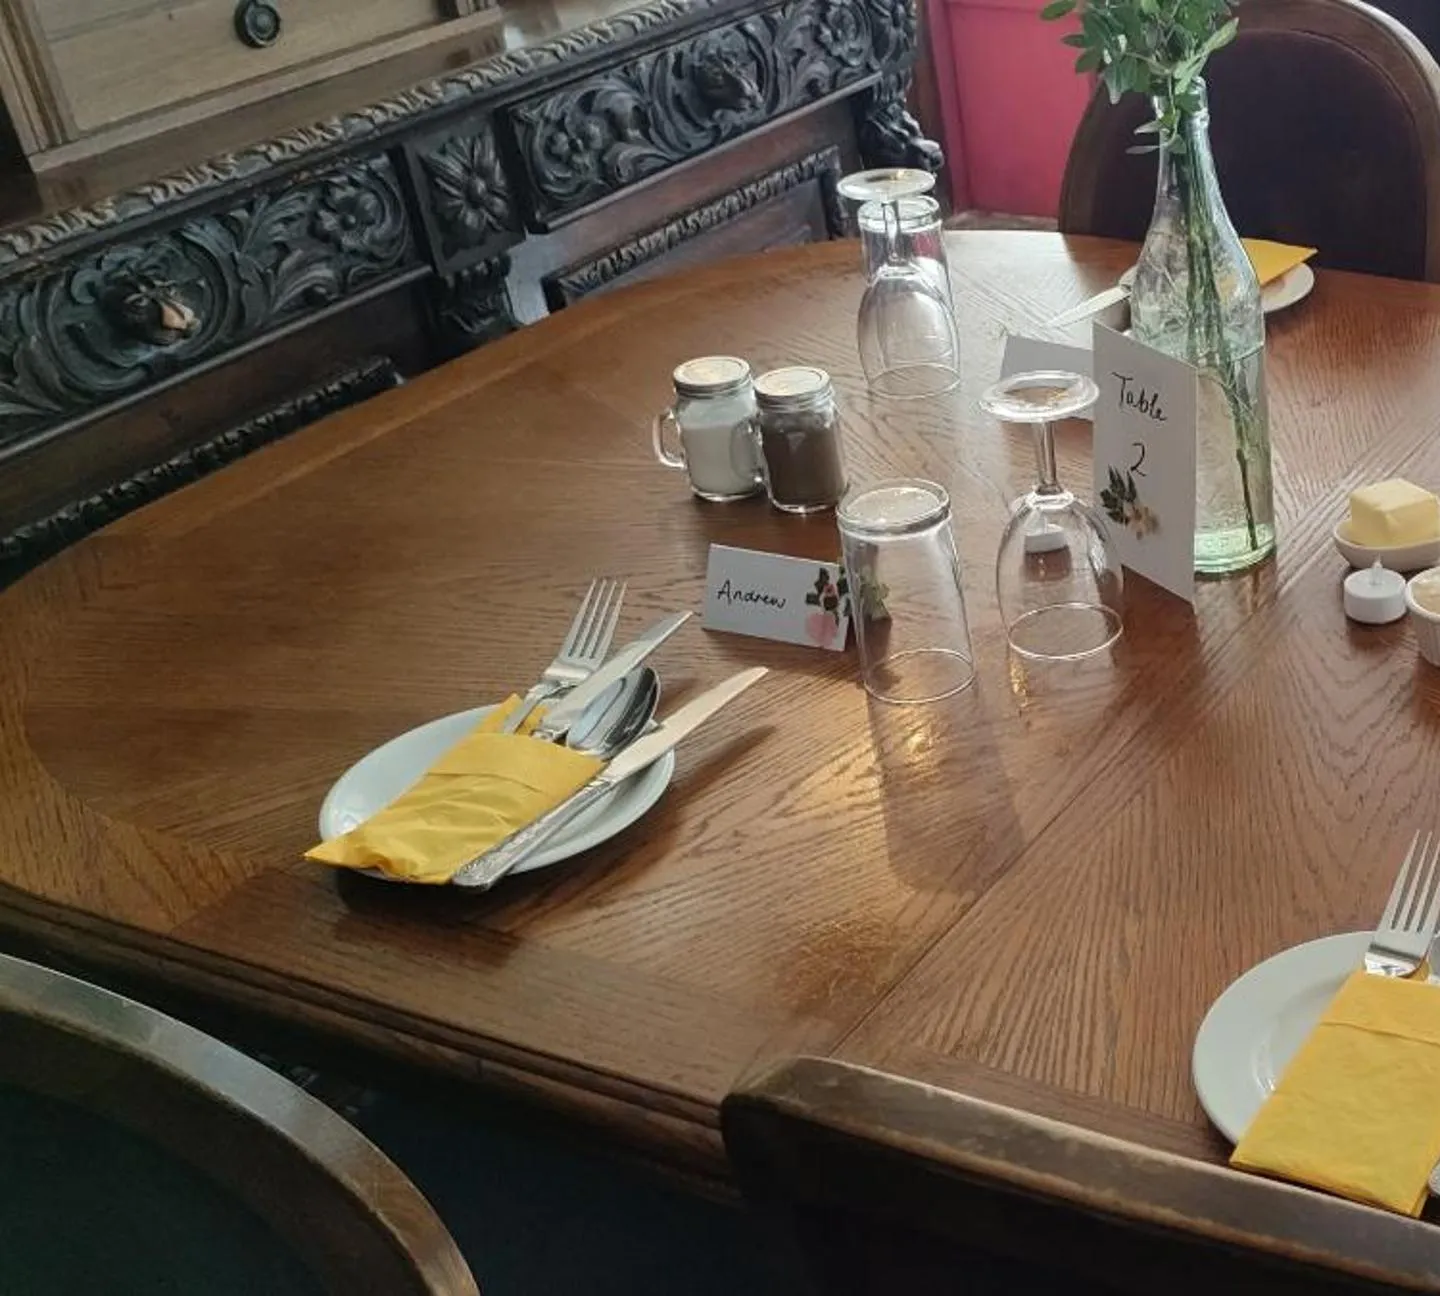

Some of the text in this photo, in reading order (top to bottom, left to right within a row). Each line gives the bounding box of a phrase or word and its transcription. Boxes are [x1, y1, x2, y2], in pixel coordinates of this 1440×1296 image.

[1112, 371, 1167, 421] Table
[1131, 442, 1147, 477] 2
[717, 579, 786, 609] Andrew
